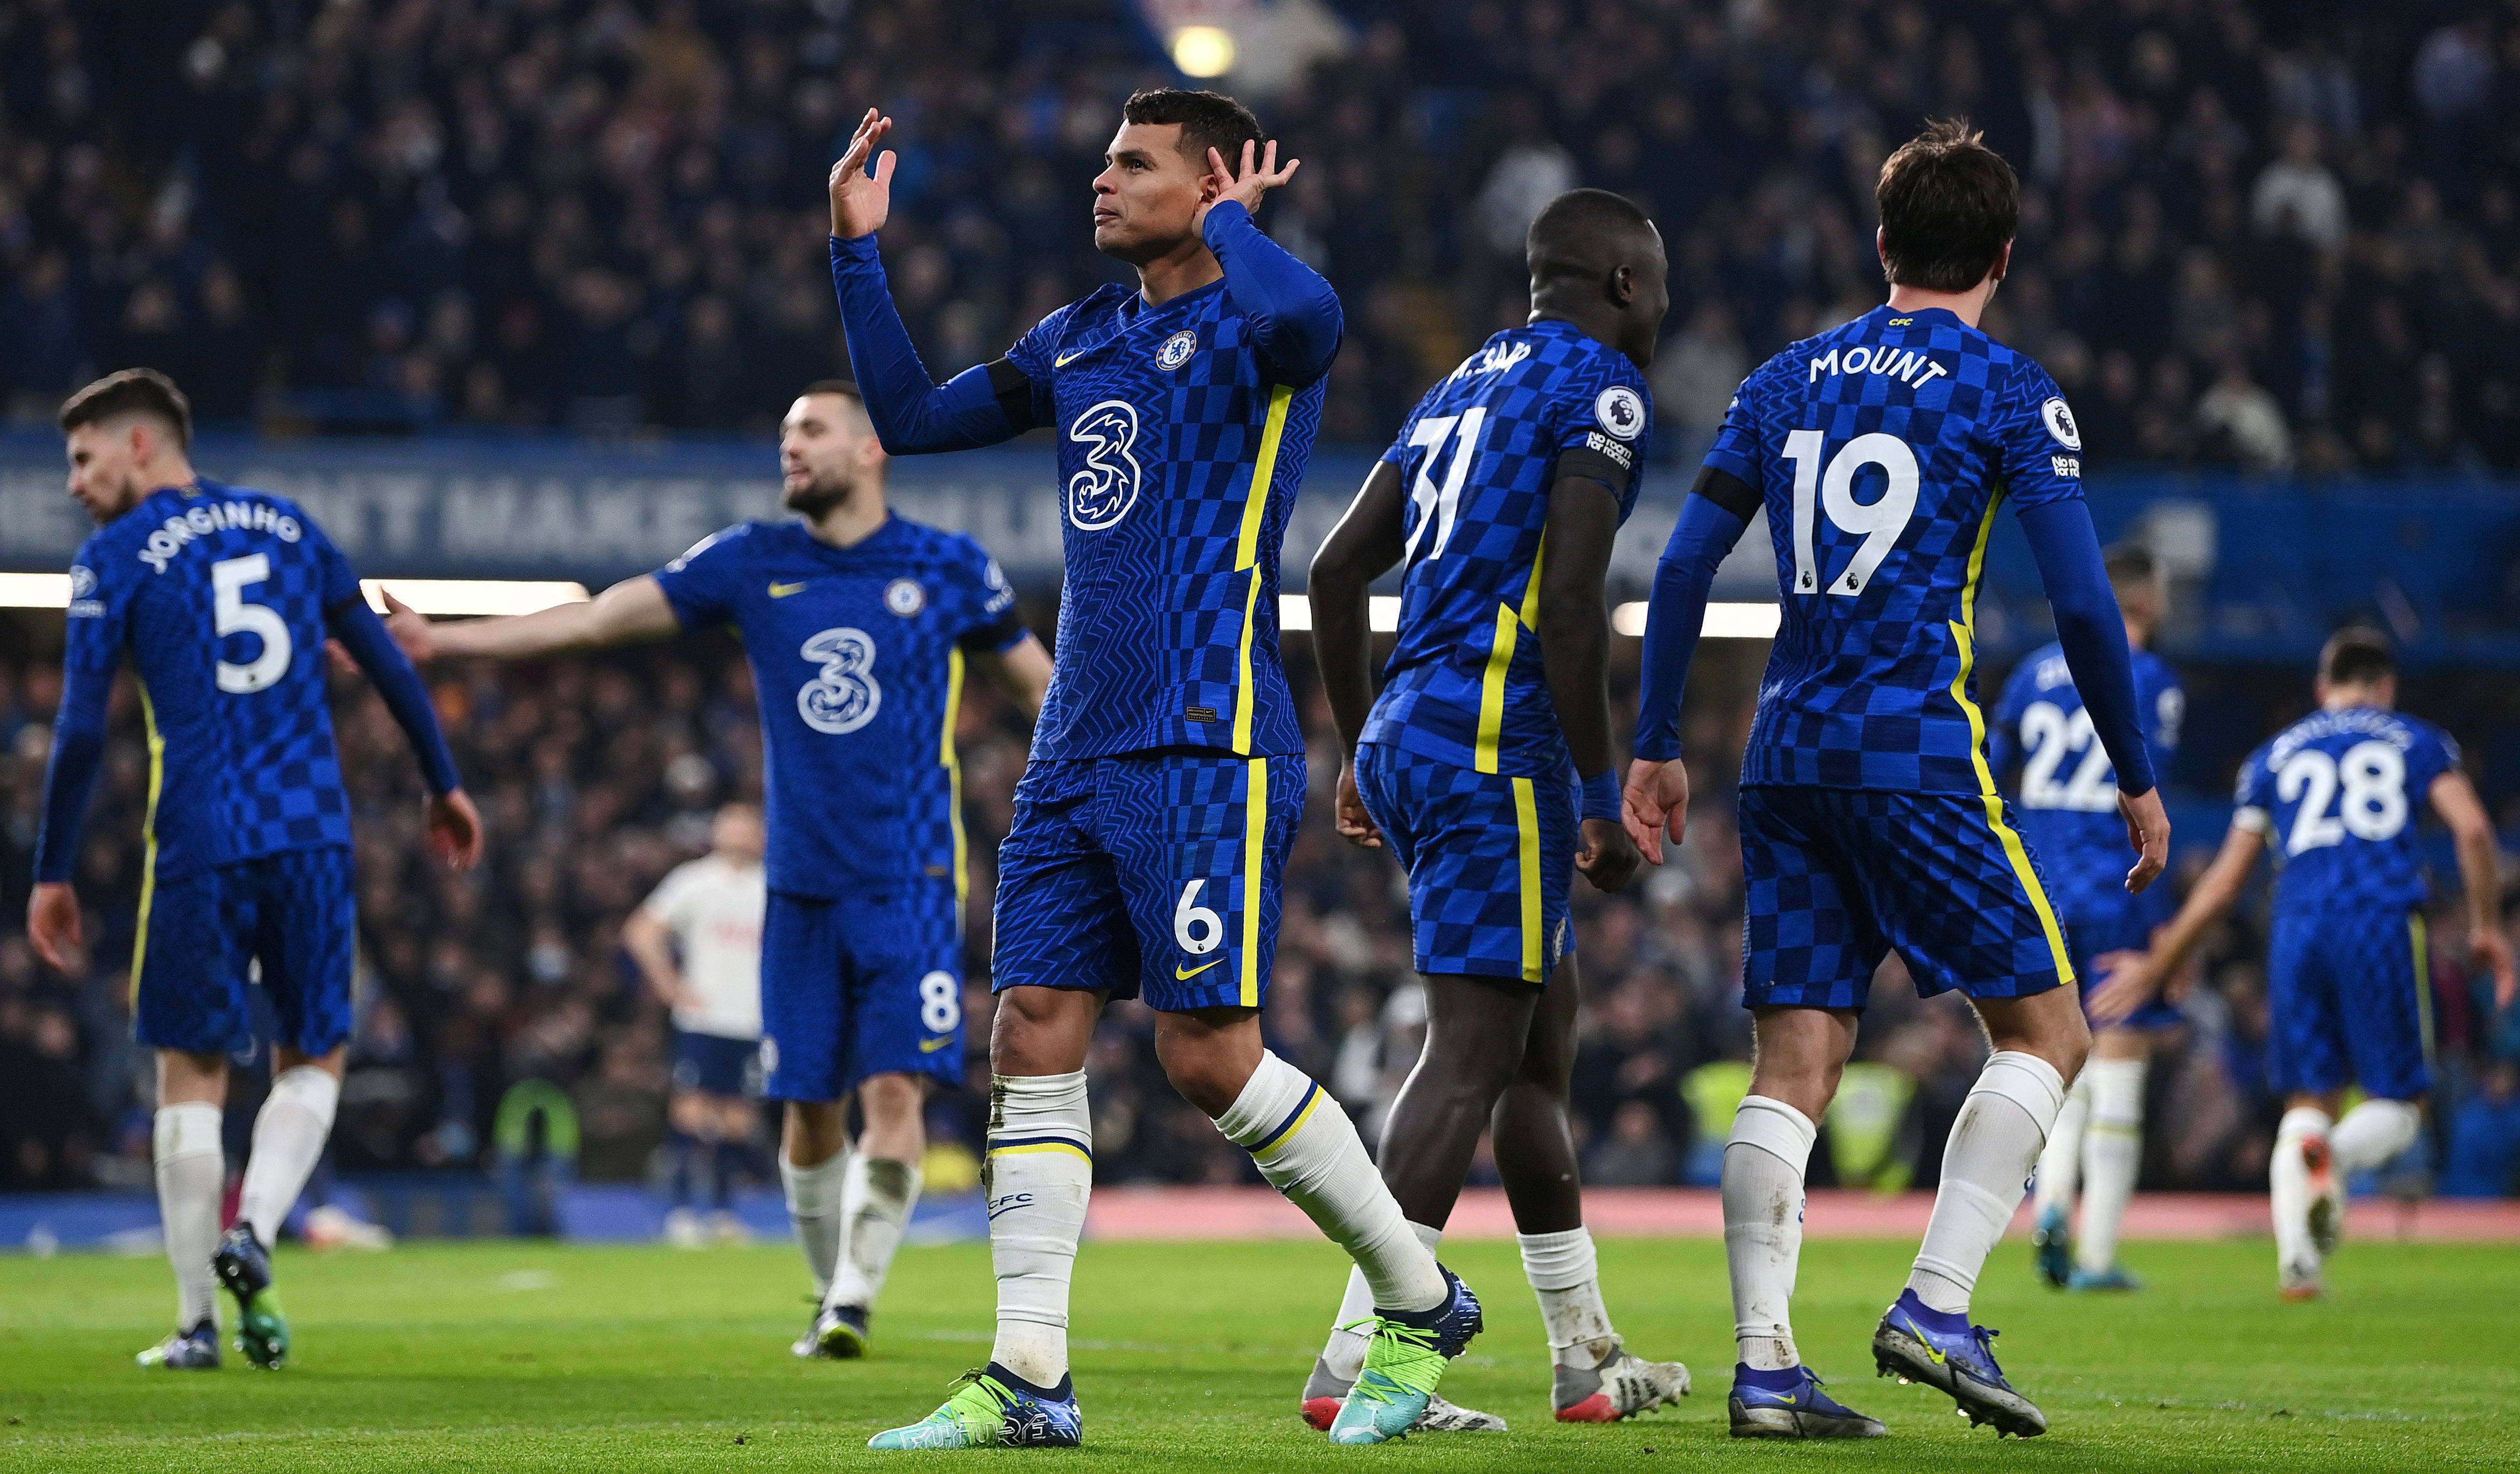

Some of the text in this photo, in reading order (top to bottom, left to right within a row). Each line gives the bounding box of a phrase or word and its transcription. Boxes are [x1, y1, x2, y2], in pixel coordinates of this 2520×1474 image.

[1889, 318, 1913, 326] CFC
[1810, 346, 1947, 390] MOUNT
[1586, 440, 1603, 451] for
[1587, 432, 1632, 460] No room
[2051, 456, 2068, 468] No
[138, 500, 302, 575] JORGINHO
[1781, 429, 1920, 597] 19
[211, 552, 293, 694] 5
[2020, 700, 2119, 813] 22
[2277, 739, 2408, 858] 28
[1174, 878, 1224, 955] 6
[918, 970, 962, 1034] 8
[988, 1193, 1034, 1209] CFC
[899, 1412, 1049, 1450] FUTURE
